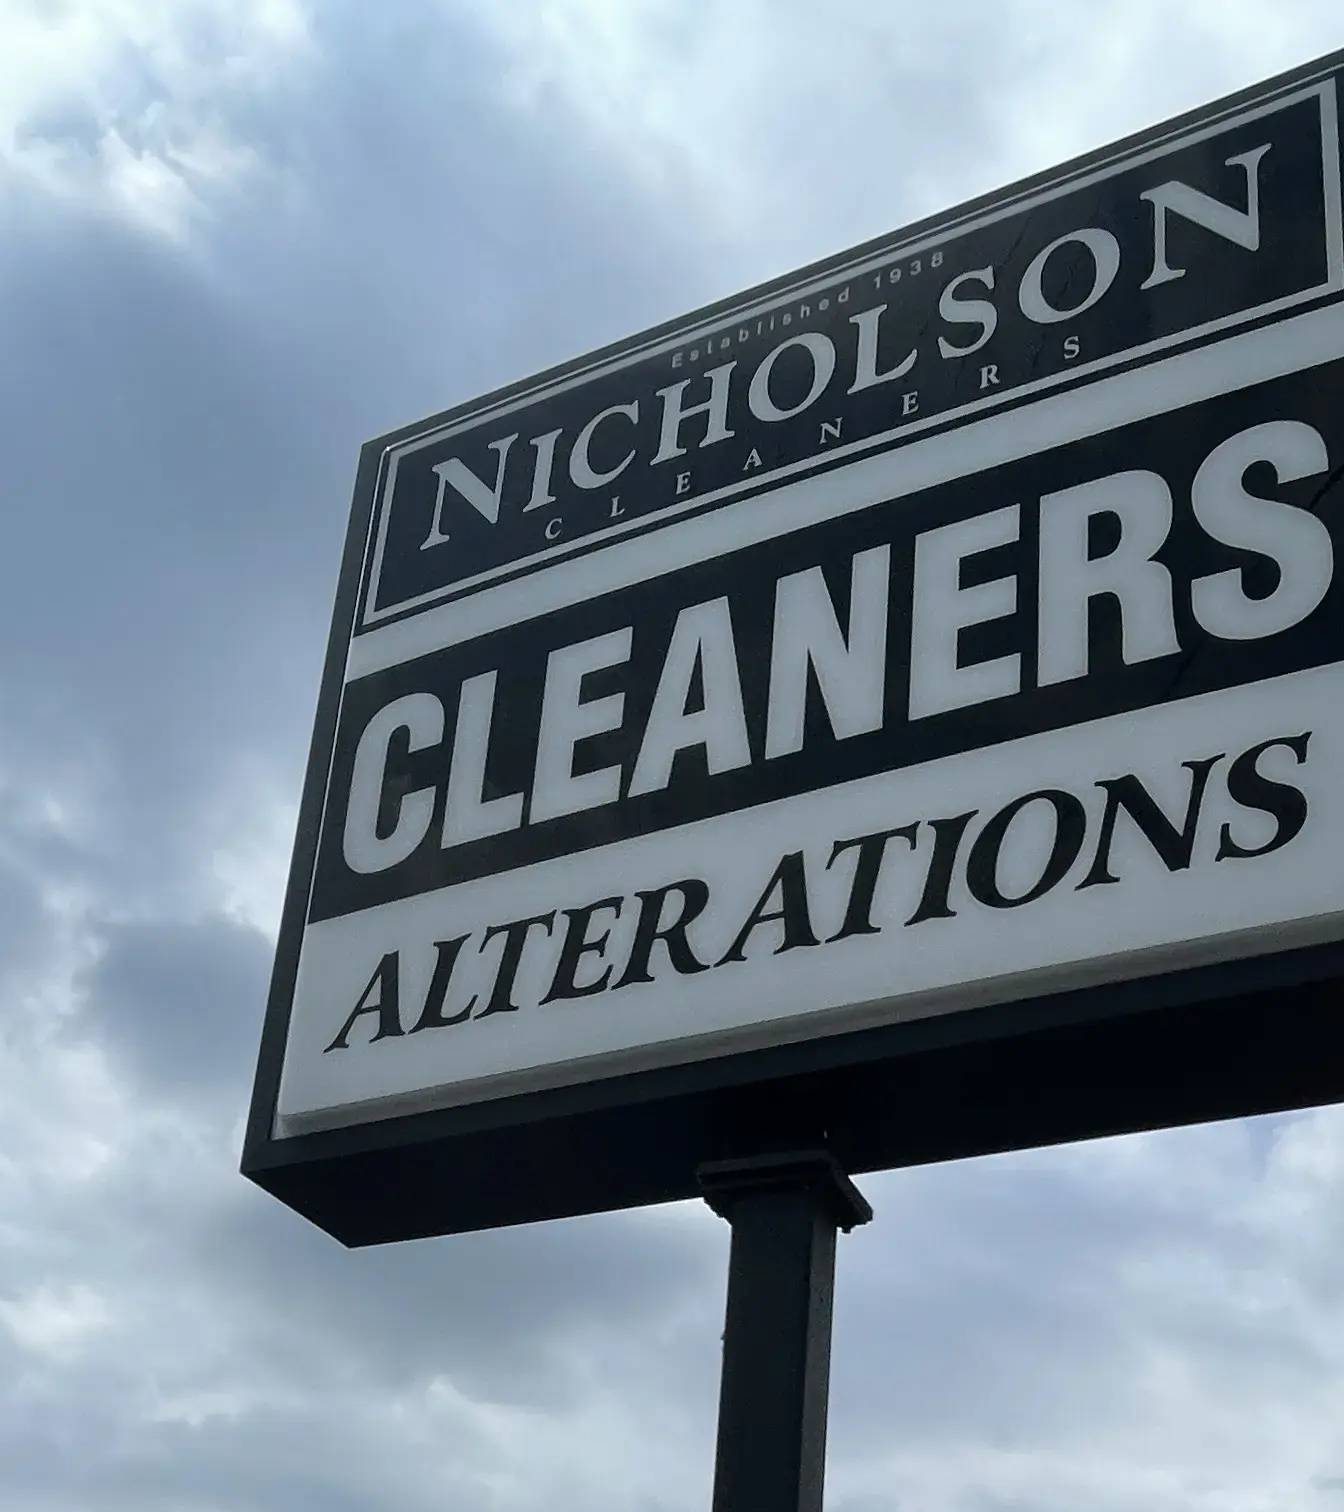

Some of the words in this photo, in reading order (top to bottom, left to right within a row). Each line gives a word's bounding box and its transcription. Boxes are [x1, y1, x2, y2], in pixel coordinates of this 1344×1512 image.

[419, 143, 1273, 550] NICHOLSON
[545, 336, 1080, 540] CLEANERS
[671, 287, 850, 368] Established
[873, 252, 943, 290] 1938
[341, 419, 1335, 876] CLEANERS
[323, 731, 1314, 1054] ALTERATIONS
